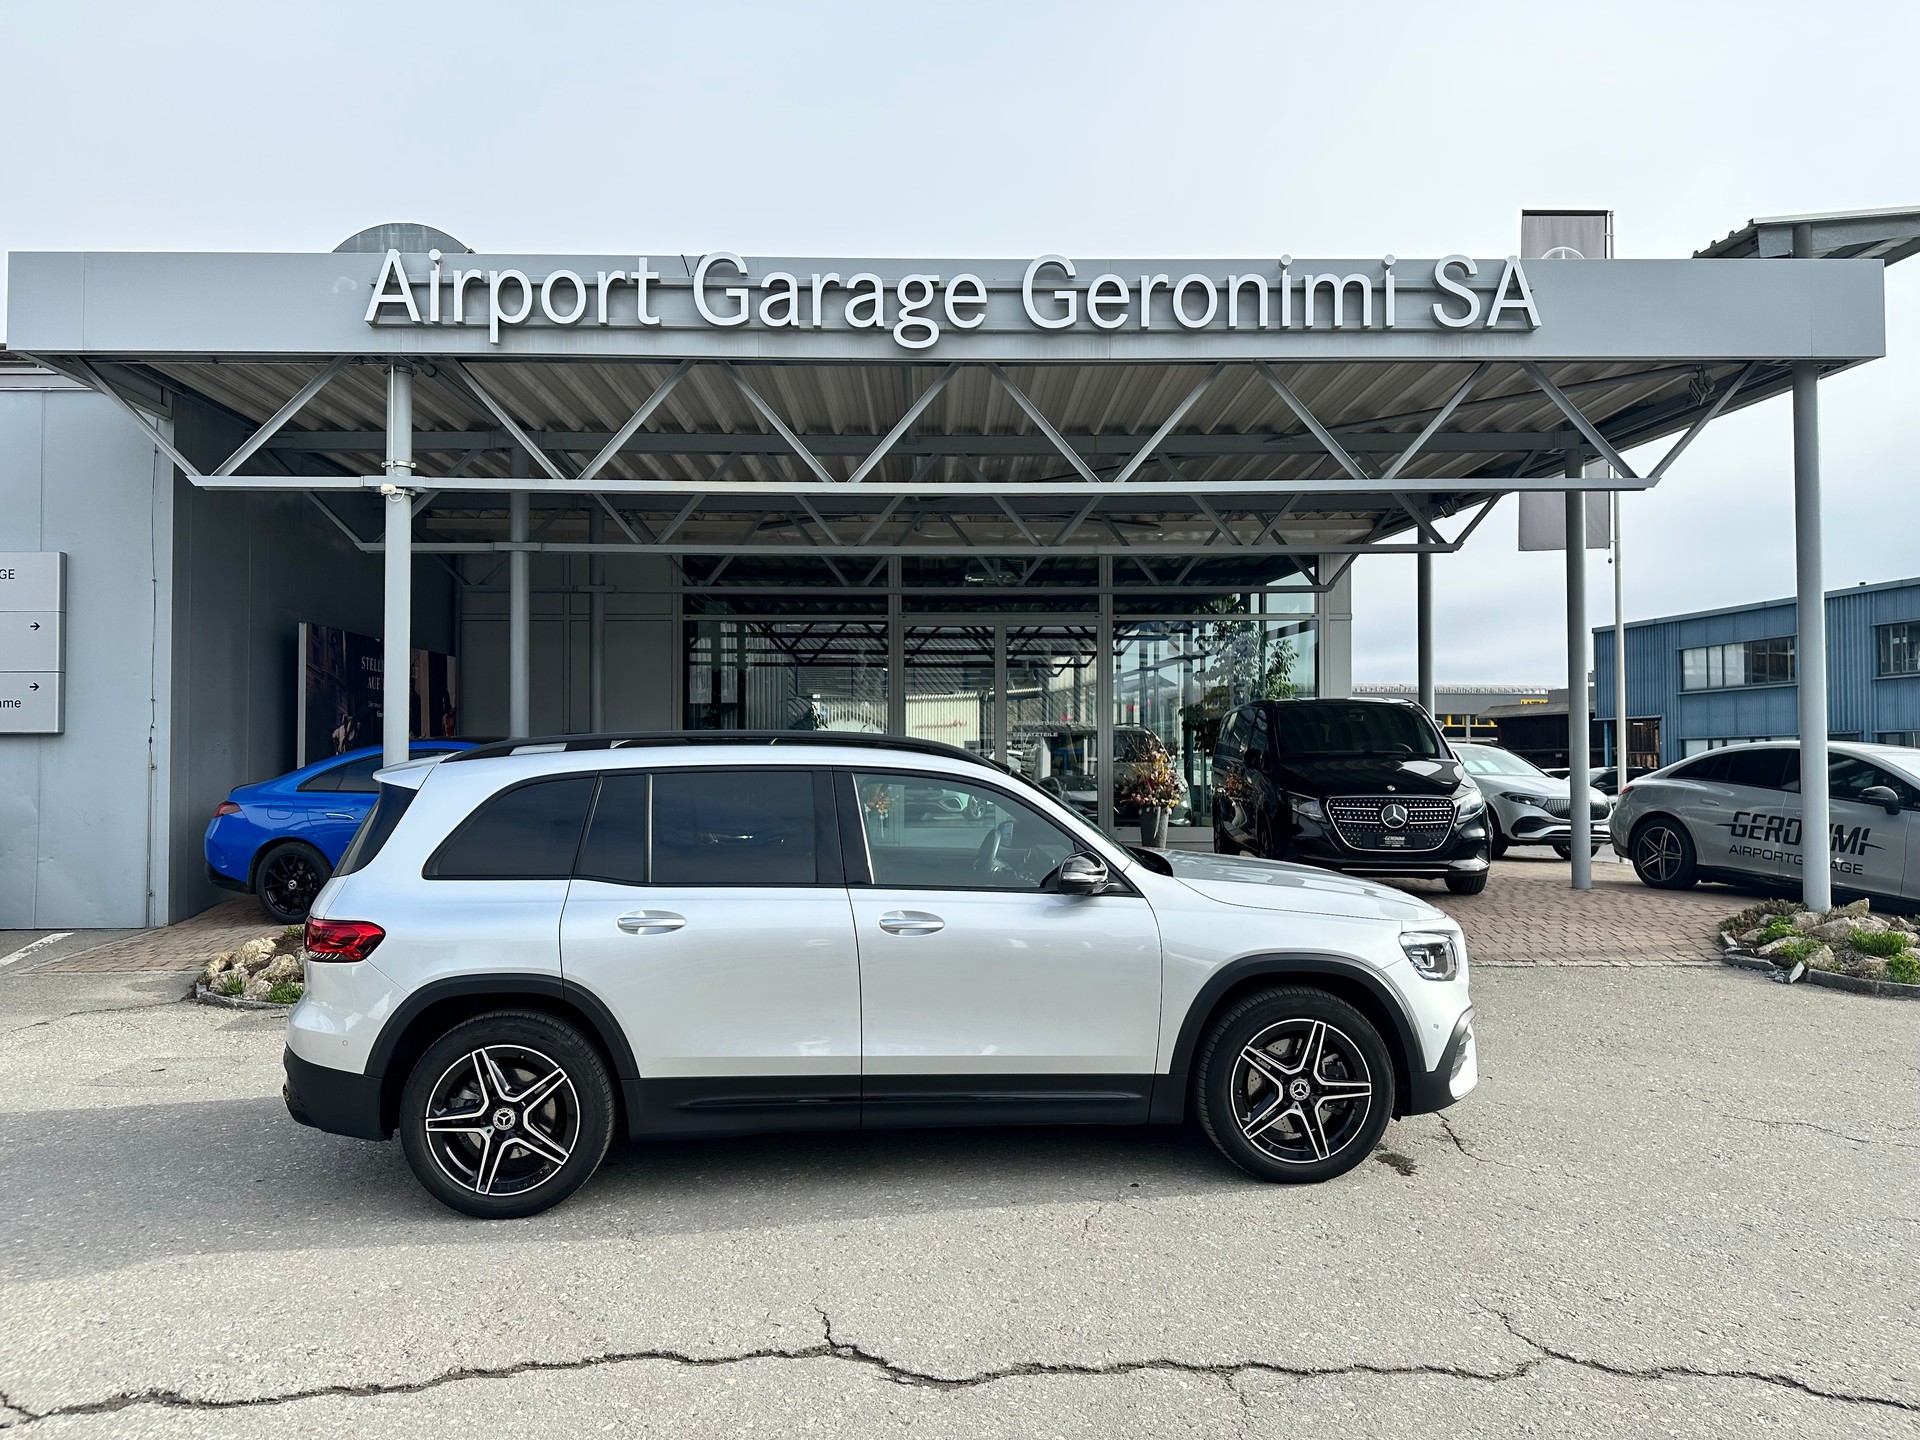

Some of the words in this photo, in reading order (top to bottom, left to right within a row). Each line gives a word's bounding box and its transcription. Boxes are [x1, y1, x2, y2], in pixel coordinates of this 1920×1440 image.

[364, 248, 661, 345] Airport
[692, 250, 988, 349] Garage
[1021, 253, 1396, 330] Geronimi
[1432, 253, 1541, 331] SA
[367, 676, 381, 690] AUF
[0, 699, 21, 708] me
[1729, 811, 1871, 856] GEROMI
[1729, 844, 1864, 875] AIRPORTGAGE
